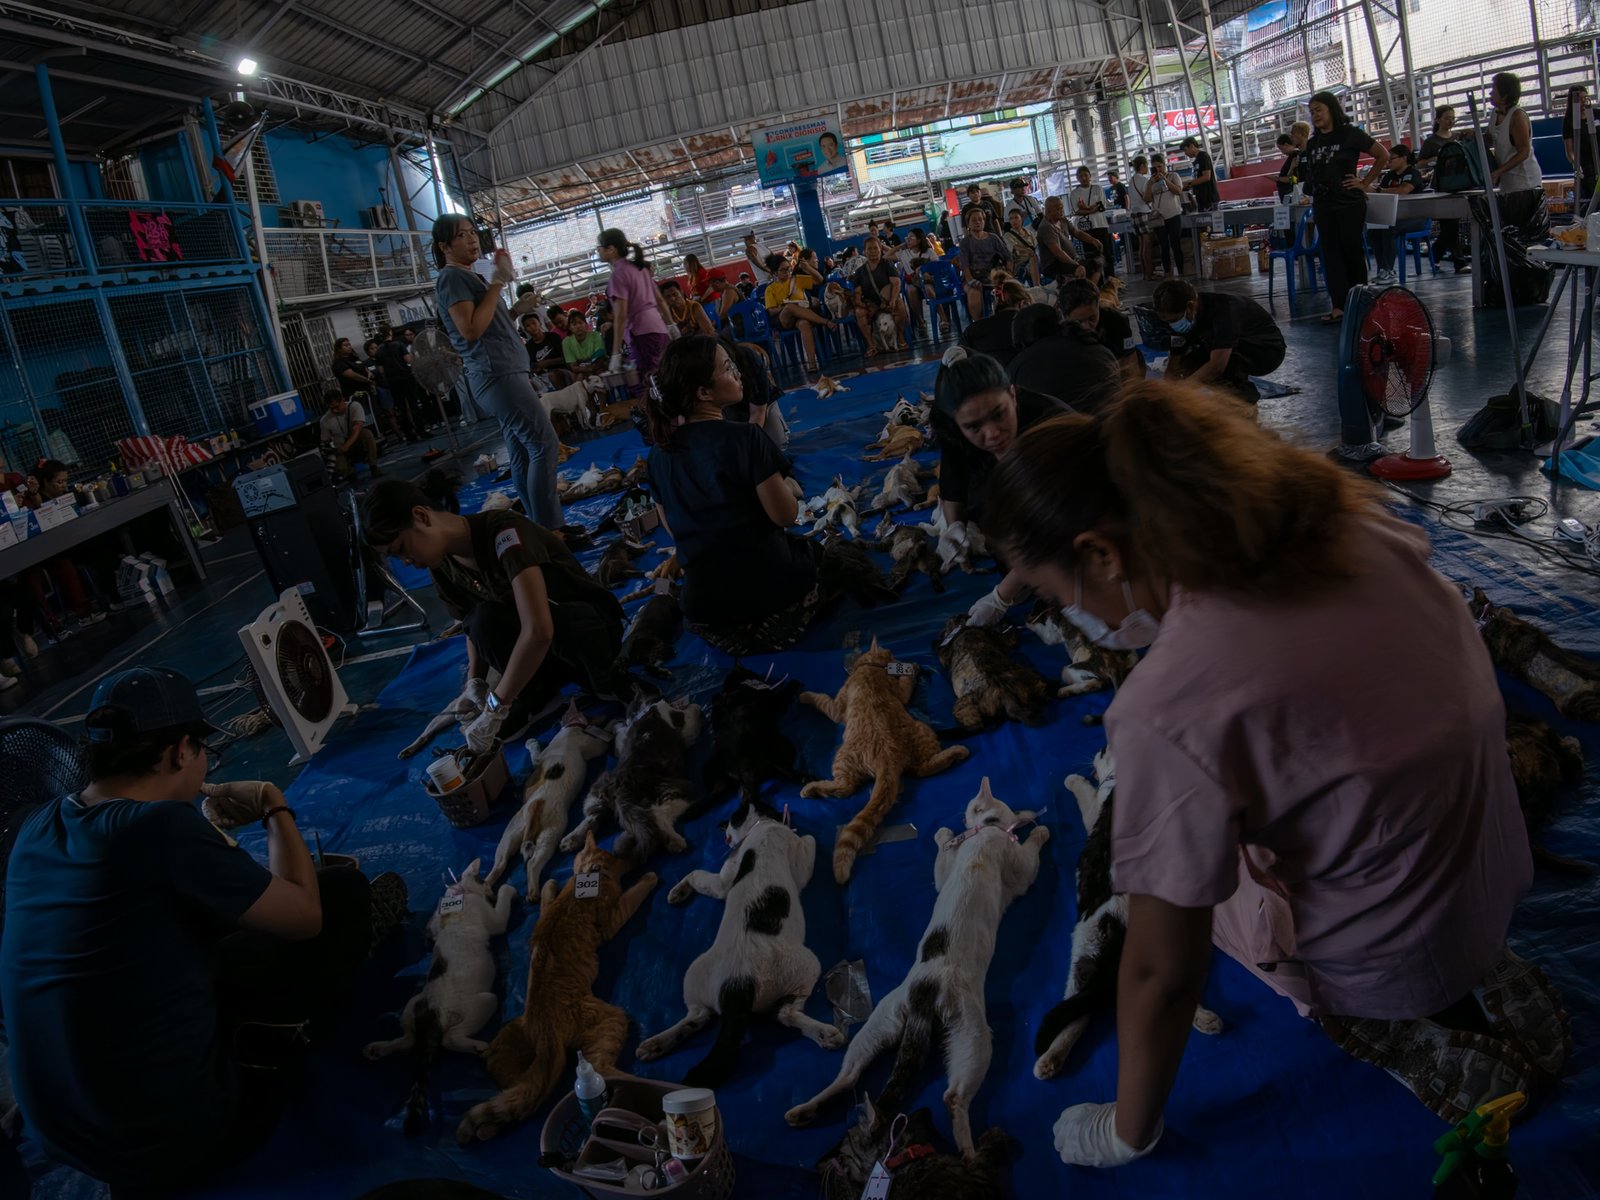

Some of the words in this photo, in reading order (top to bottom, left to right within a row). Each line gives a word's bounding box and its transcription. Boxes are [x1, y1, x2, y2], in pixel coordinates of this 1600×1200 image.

[1173, 107, 1212, 128] Coca-Cla
[794, 126, 827, 138] DIONISIO
[576, 880, 598, 889] 302
[441, 899, 462, 909] 300
